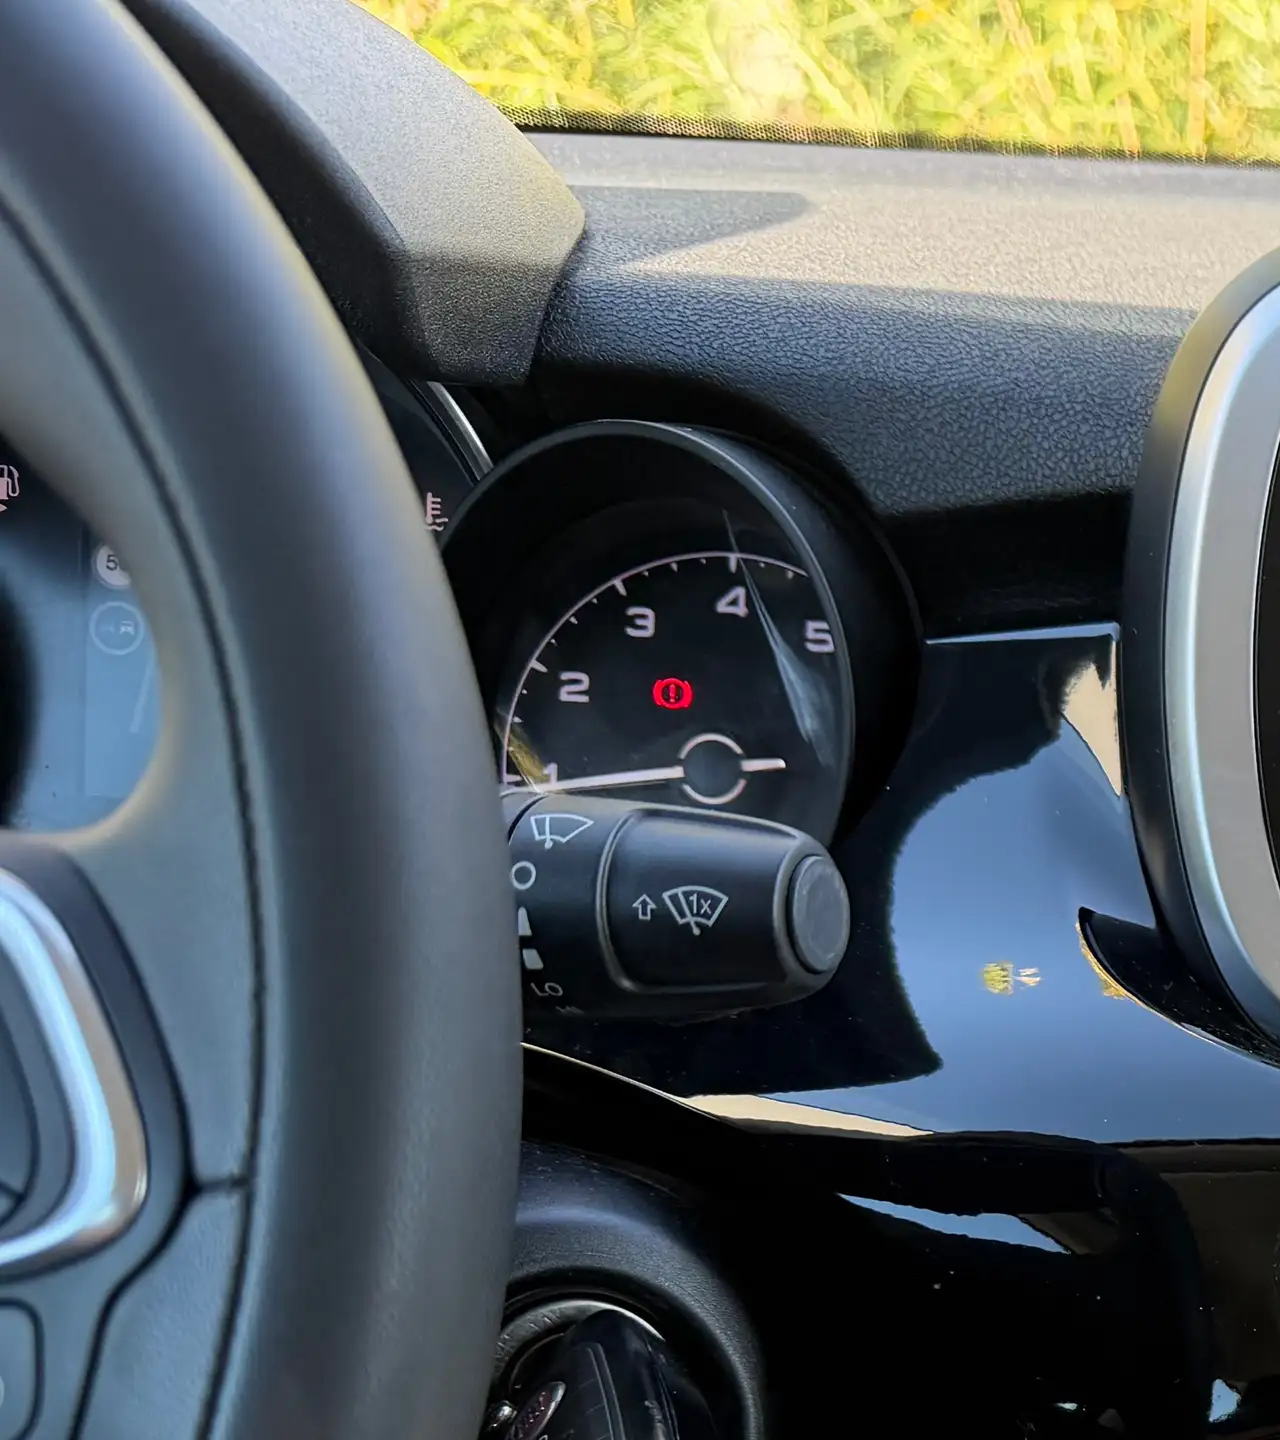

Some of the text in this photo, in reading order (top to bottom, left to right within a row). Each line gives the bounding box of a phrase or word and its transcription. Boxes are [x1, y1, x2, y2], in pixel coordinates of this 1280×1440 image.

[715, 585, 749, 618] 4
[624, 606, 656, 638] 3
[803, 619, 836, 654] 5
[558, 671, 591, 704] 2
[688, 892, 712, 914] 1x
